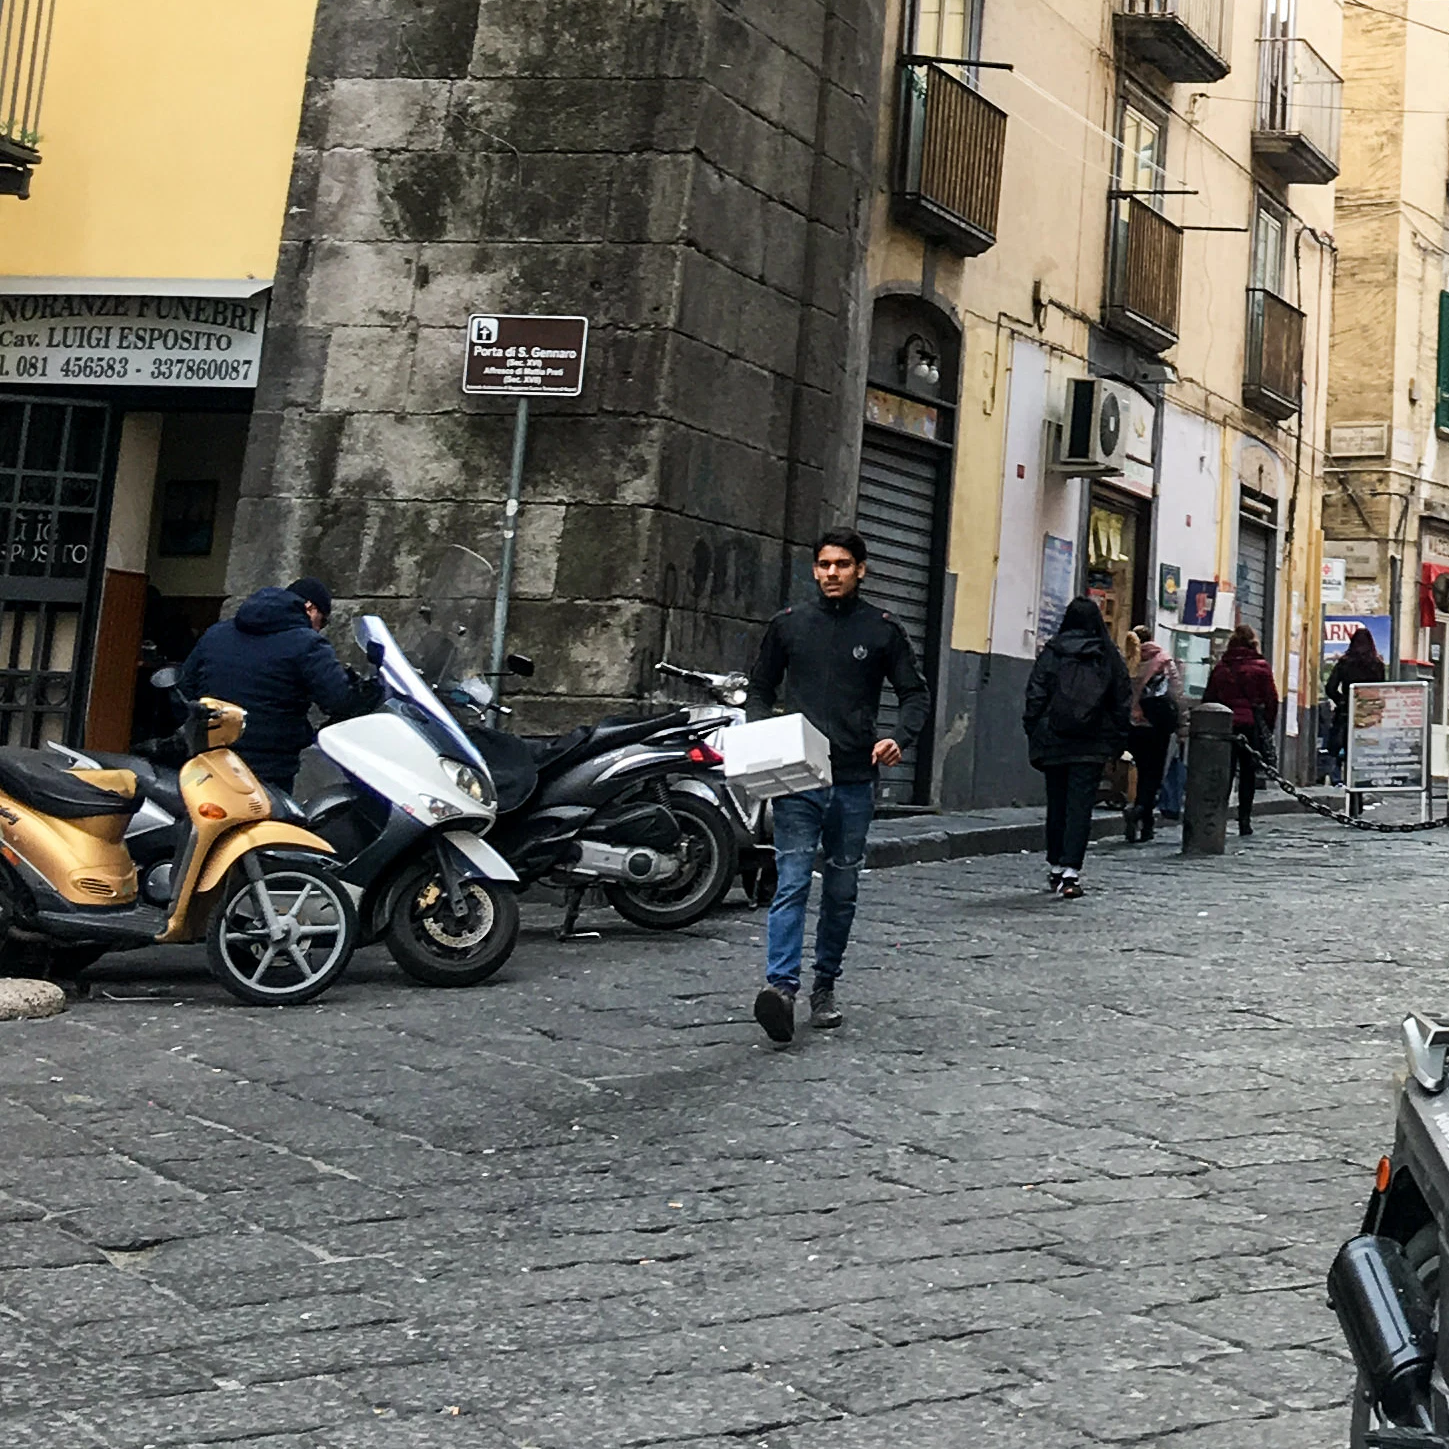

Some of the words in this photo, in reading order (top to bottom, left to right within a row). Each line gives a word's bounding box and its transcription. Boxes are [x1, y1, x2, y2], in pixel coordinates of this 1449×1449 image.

[137, 295, 259, 335] FUNEBRI
[0, 330, 40, 348] Cav.
[46, 326, 112, 349] LUIGI
[116, 327, 232, 351] ESPOSITO
[474, 345, 503, 357] Porta
[505, 346, 516, 358] di
[518, 347, 529, 358] S.
[531, 347, 577, 359] Gennaro
[16, 355, 48, 377] 081
[60, 356, 128, 379] 456583
[151, 357, 253, 381] 337860087
